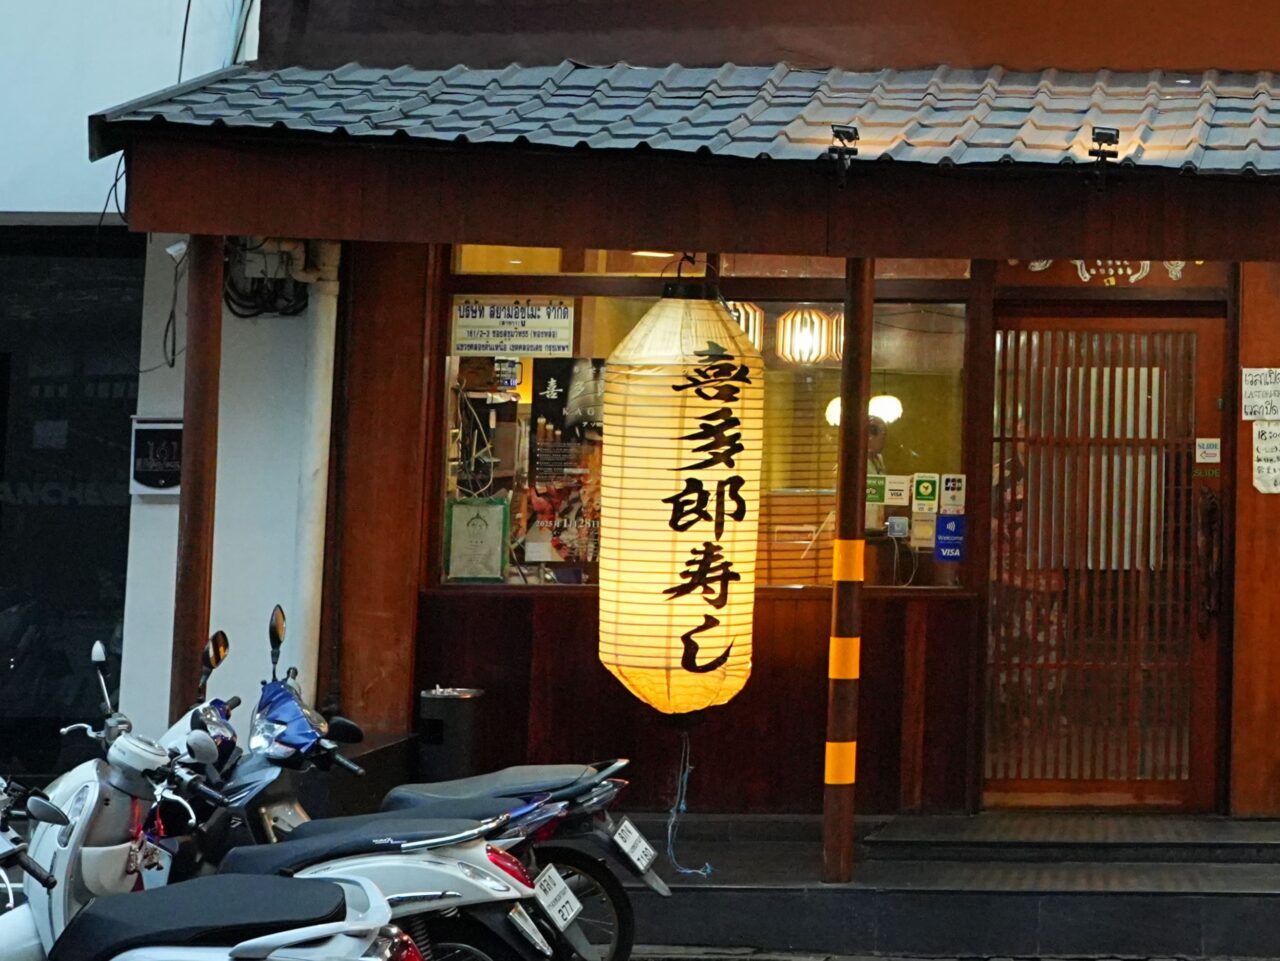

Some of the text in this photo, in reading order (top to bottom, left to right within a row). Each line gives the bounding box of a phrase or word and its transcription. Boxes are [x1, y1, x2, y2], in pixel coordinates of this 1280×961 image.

[660, 340, 753, 675] 喜多郎寿し
[941, 548, 961, 557] VISA
[558, 900, 575, 922] 277
